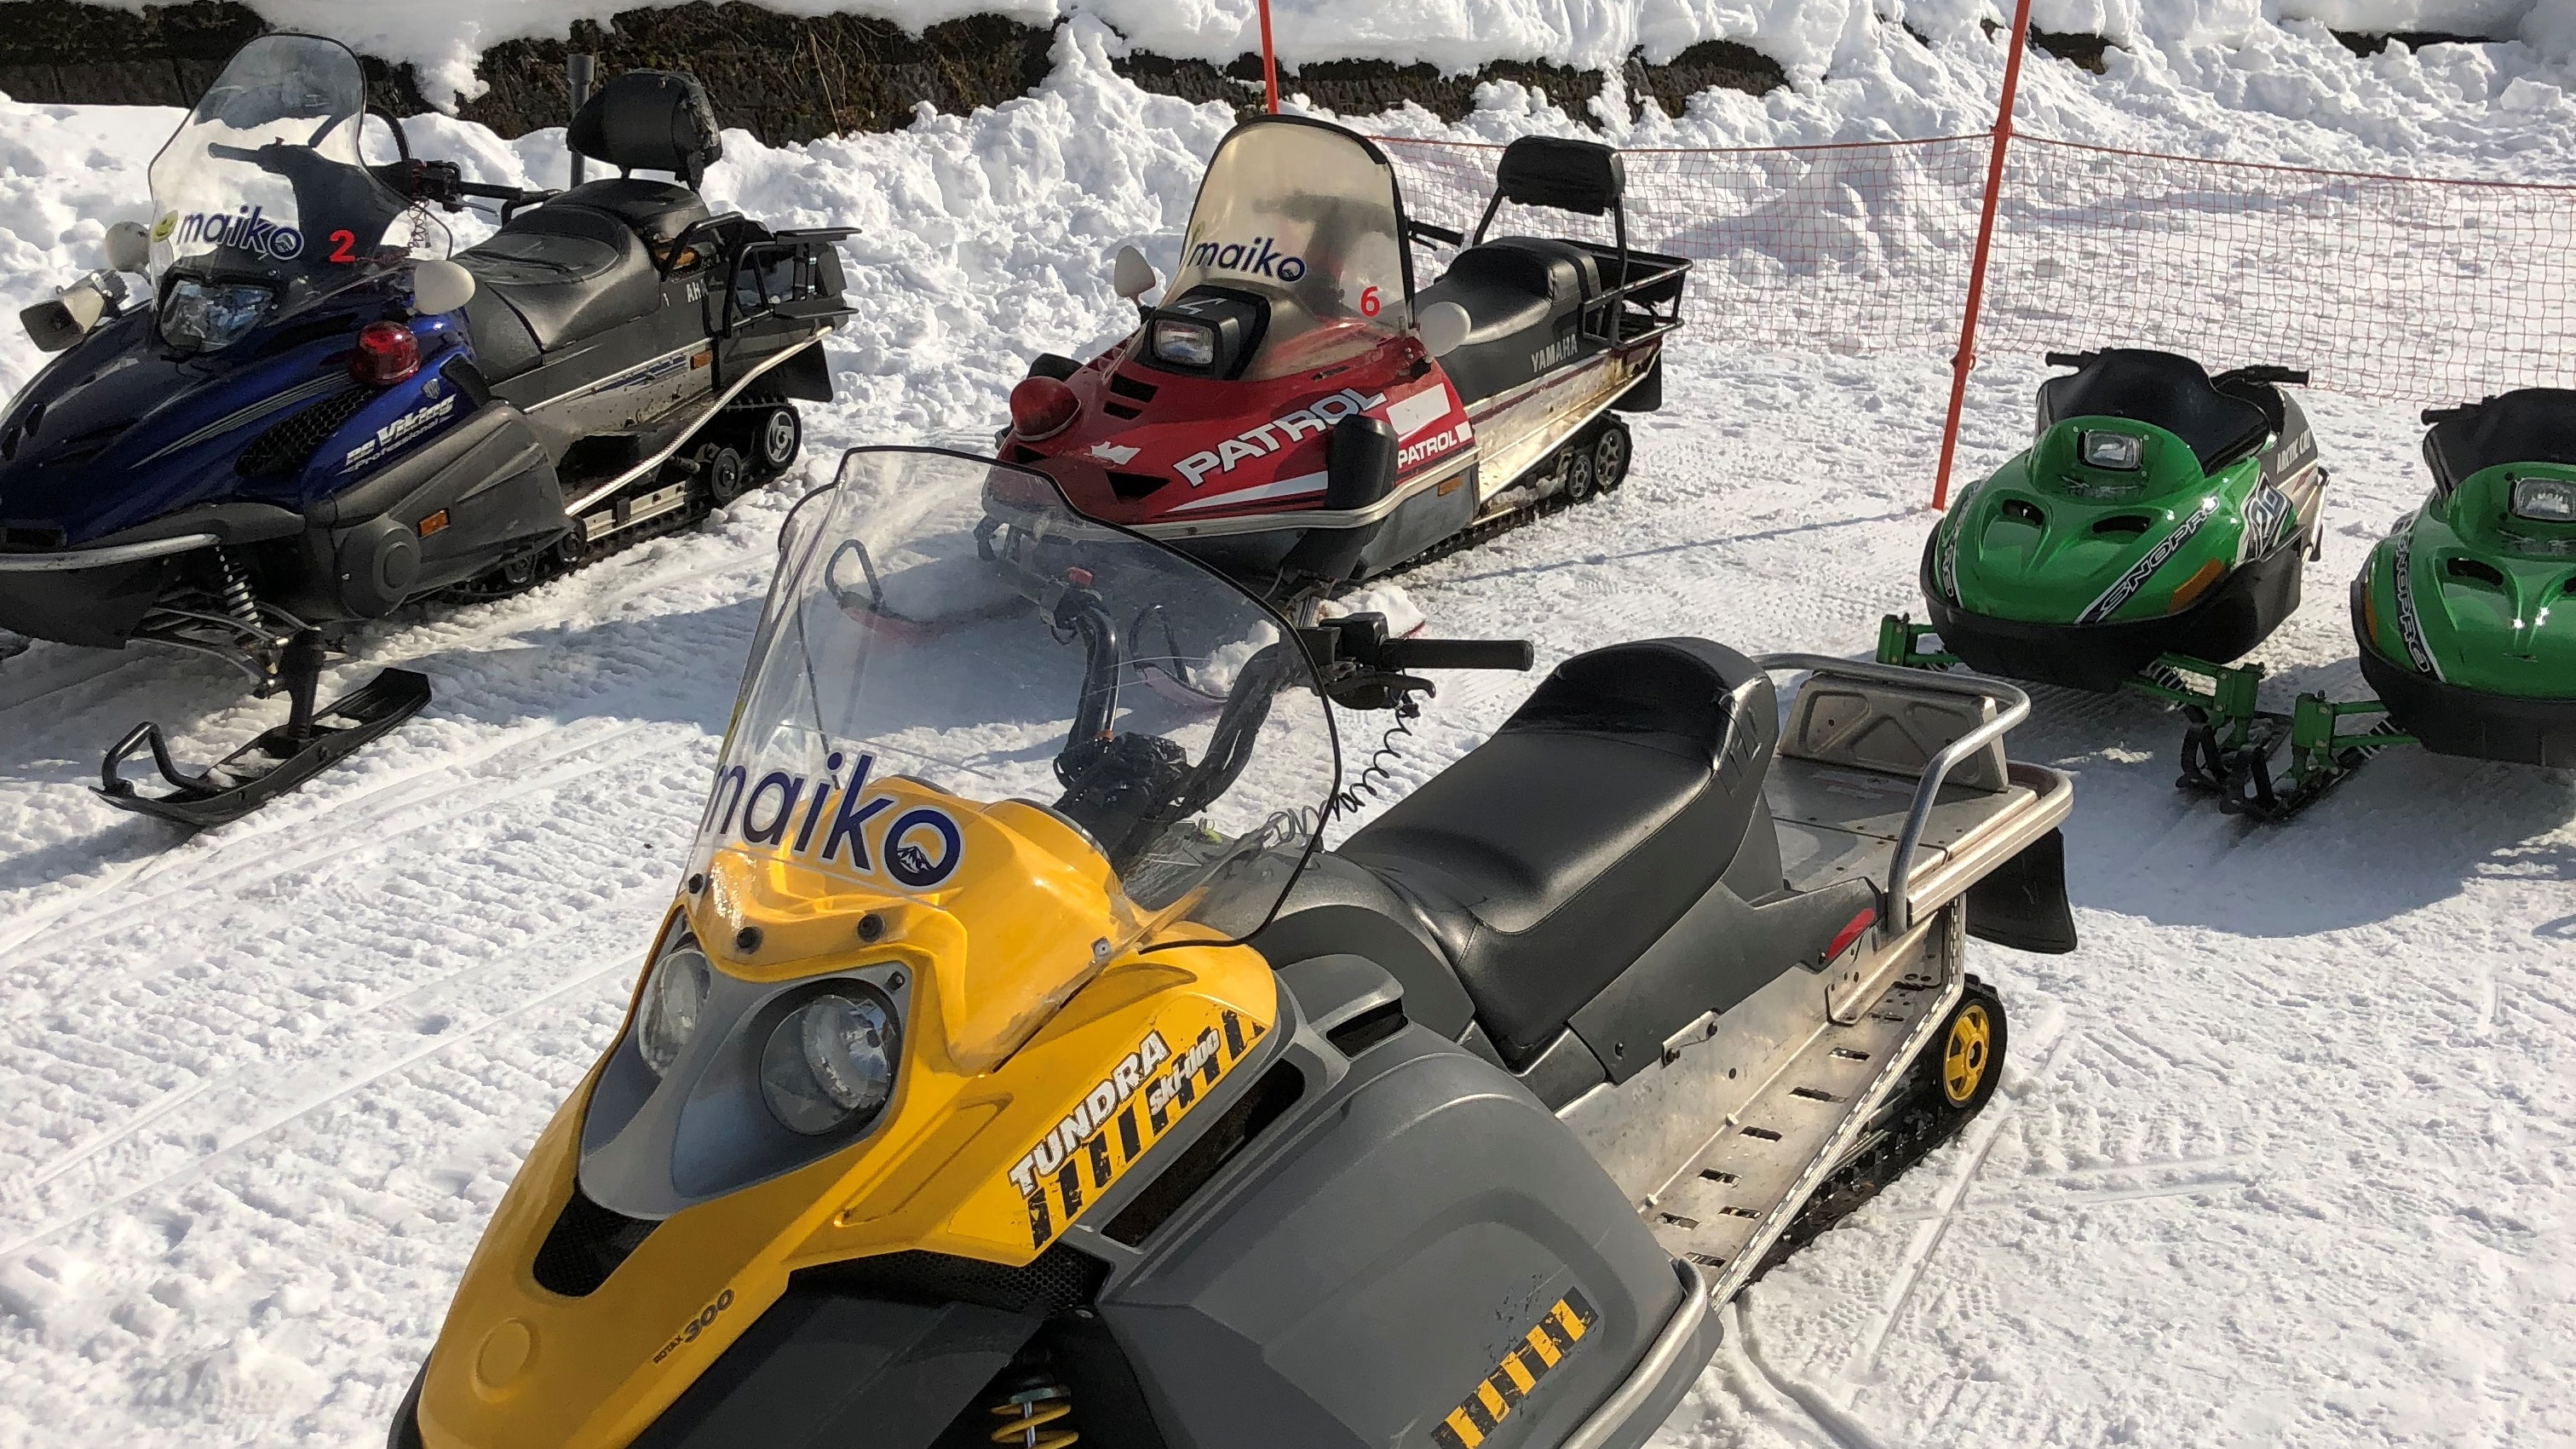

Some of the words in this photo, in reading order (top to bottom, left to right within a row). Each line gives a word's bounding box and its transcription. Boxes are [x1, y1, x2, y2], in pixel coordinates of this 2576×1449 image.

[176, 204, 304, 260] maiko
[329, 229, 355, 262] 2
[1187, 237, 1306, 282] maiko
[1360, 286, 1381, 317] 6
[1531, 333, 1578, 373] YAMAHA
[376, 394, 457, 446] Viking
[1172, 388, 1387, 487] PATROL
[1397, 429, 1458, 469] PATROL
[1007, 1027, 1173, 1199] TUNDRA
[653, 1334, 683, 1364] ROTAX
[684, 1289, 735, 1343] 300
